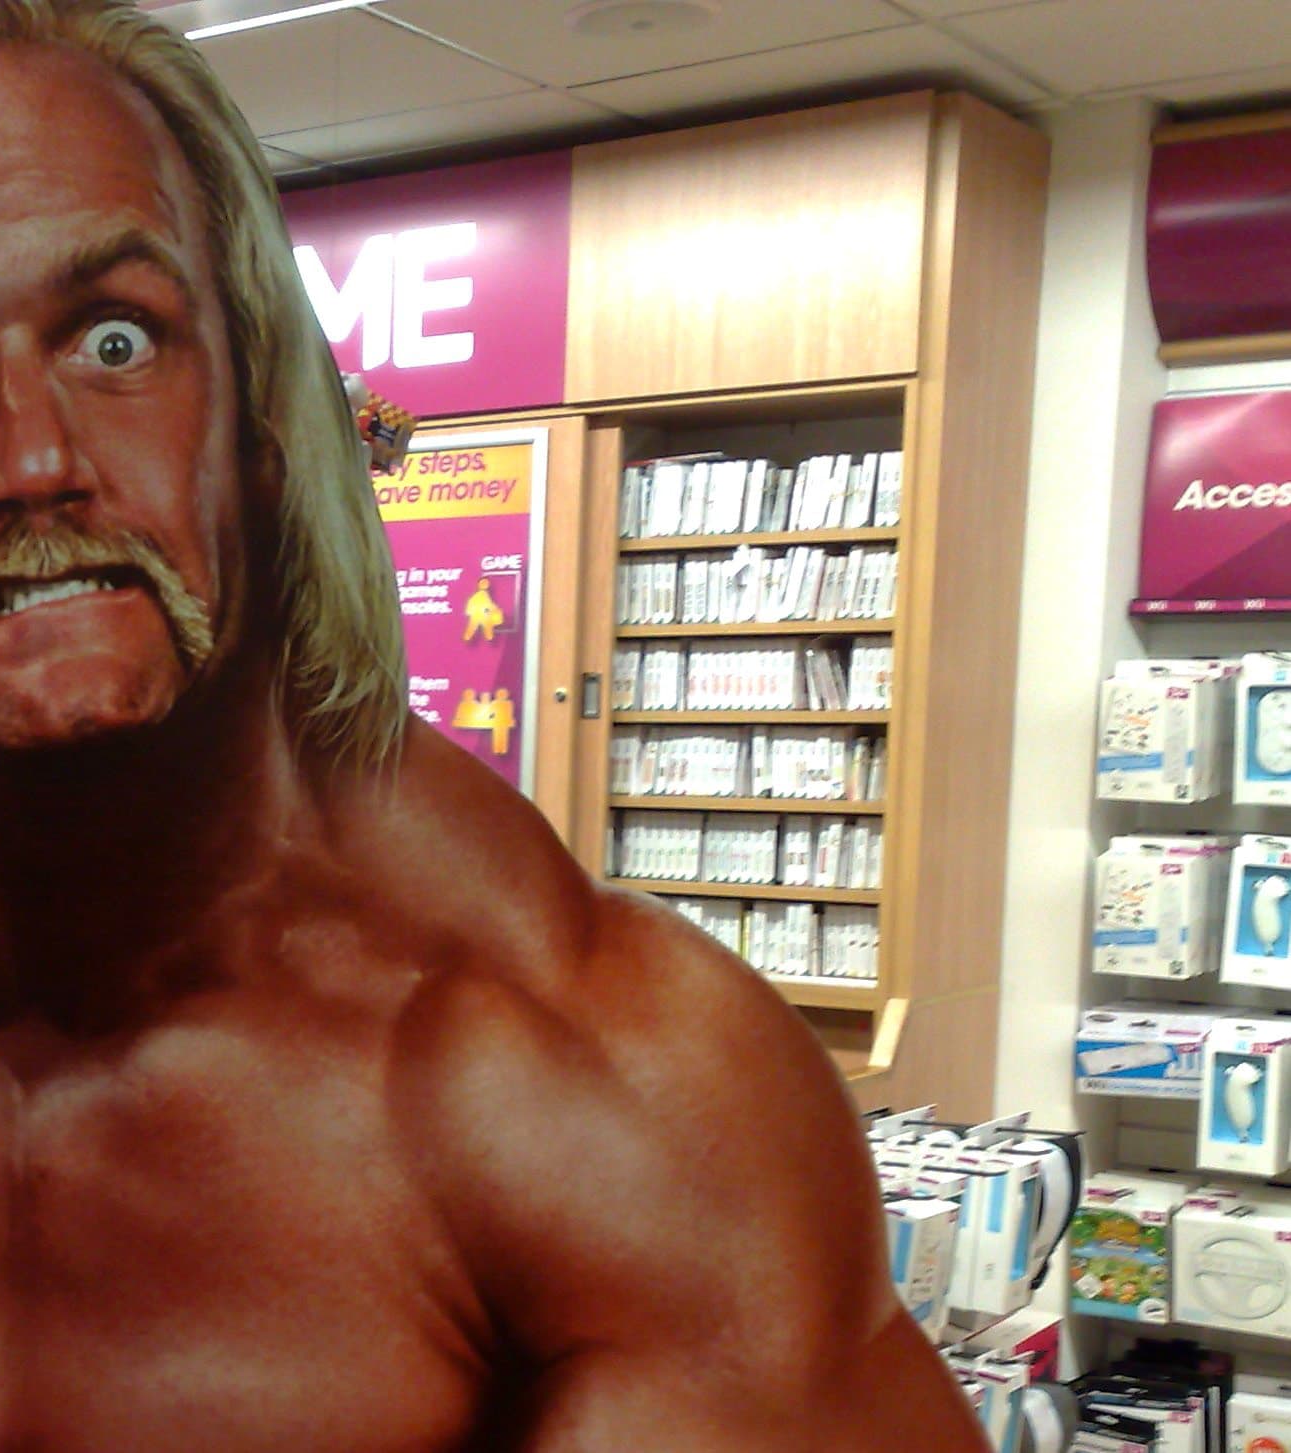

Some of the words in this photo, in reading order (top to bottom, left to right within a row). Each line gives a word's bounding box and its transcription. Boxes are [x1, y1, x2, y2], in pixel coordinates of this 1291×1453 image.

[292, 221, 478, 371] ME
[372, 482, 421, 505] ave
[428, 479, 517, 502] money
[480, 553, 524, 570] GAME
[427, 567, 464, 585] your
